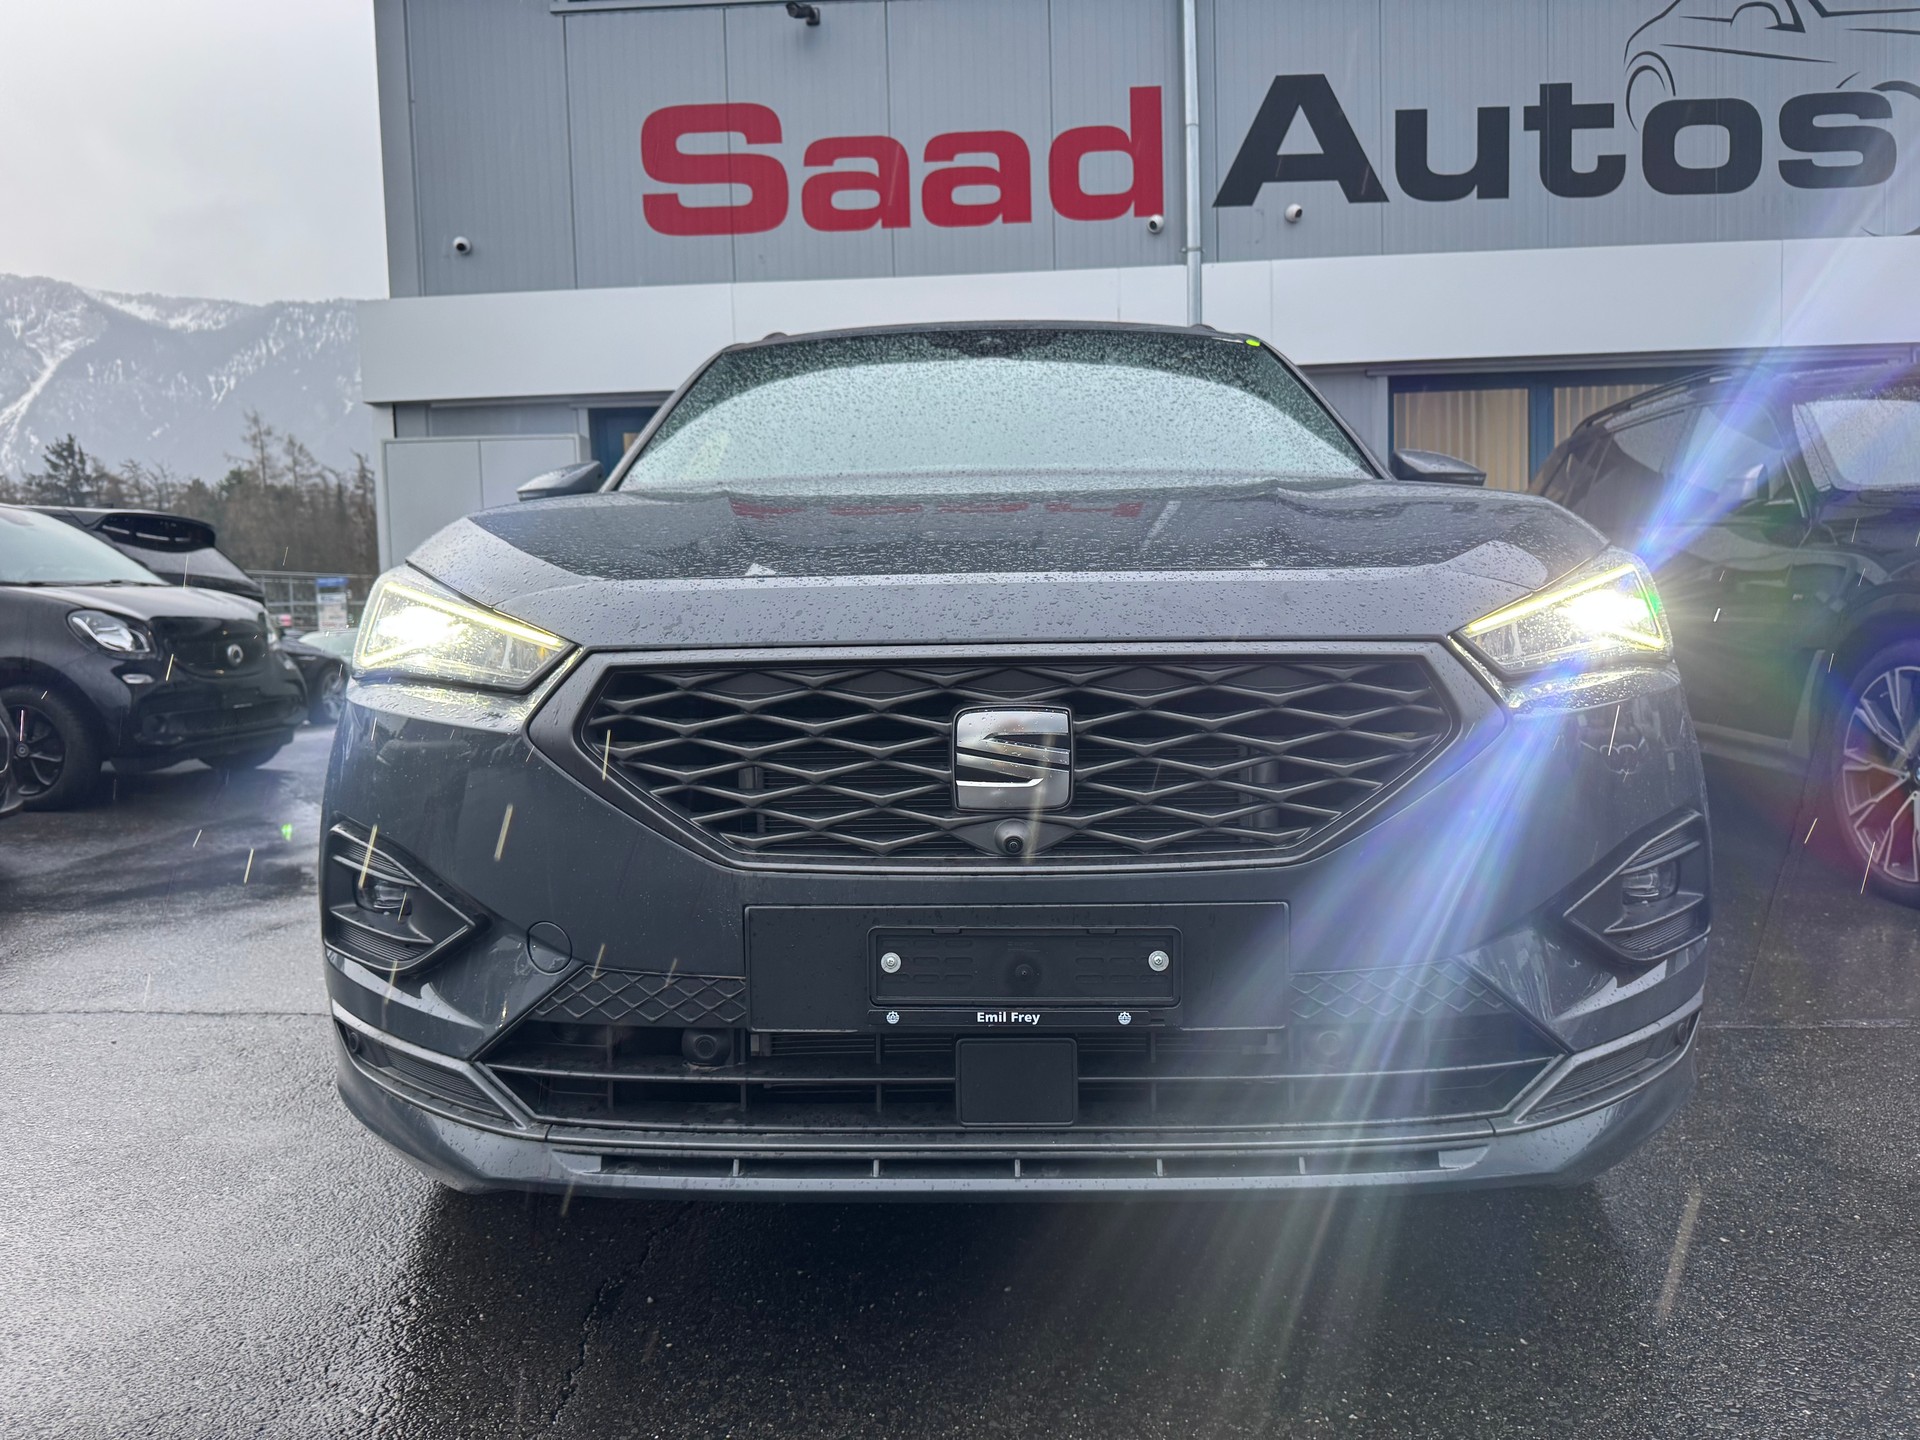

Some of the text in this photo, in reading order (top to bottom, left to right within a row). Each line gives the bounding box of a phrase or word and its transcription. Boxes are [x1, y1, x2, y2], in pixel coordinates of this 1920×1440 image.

[641, 73, 1897, 236] Saad Autos
[977, 1011, 1040, 1025] Emil Frey
